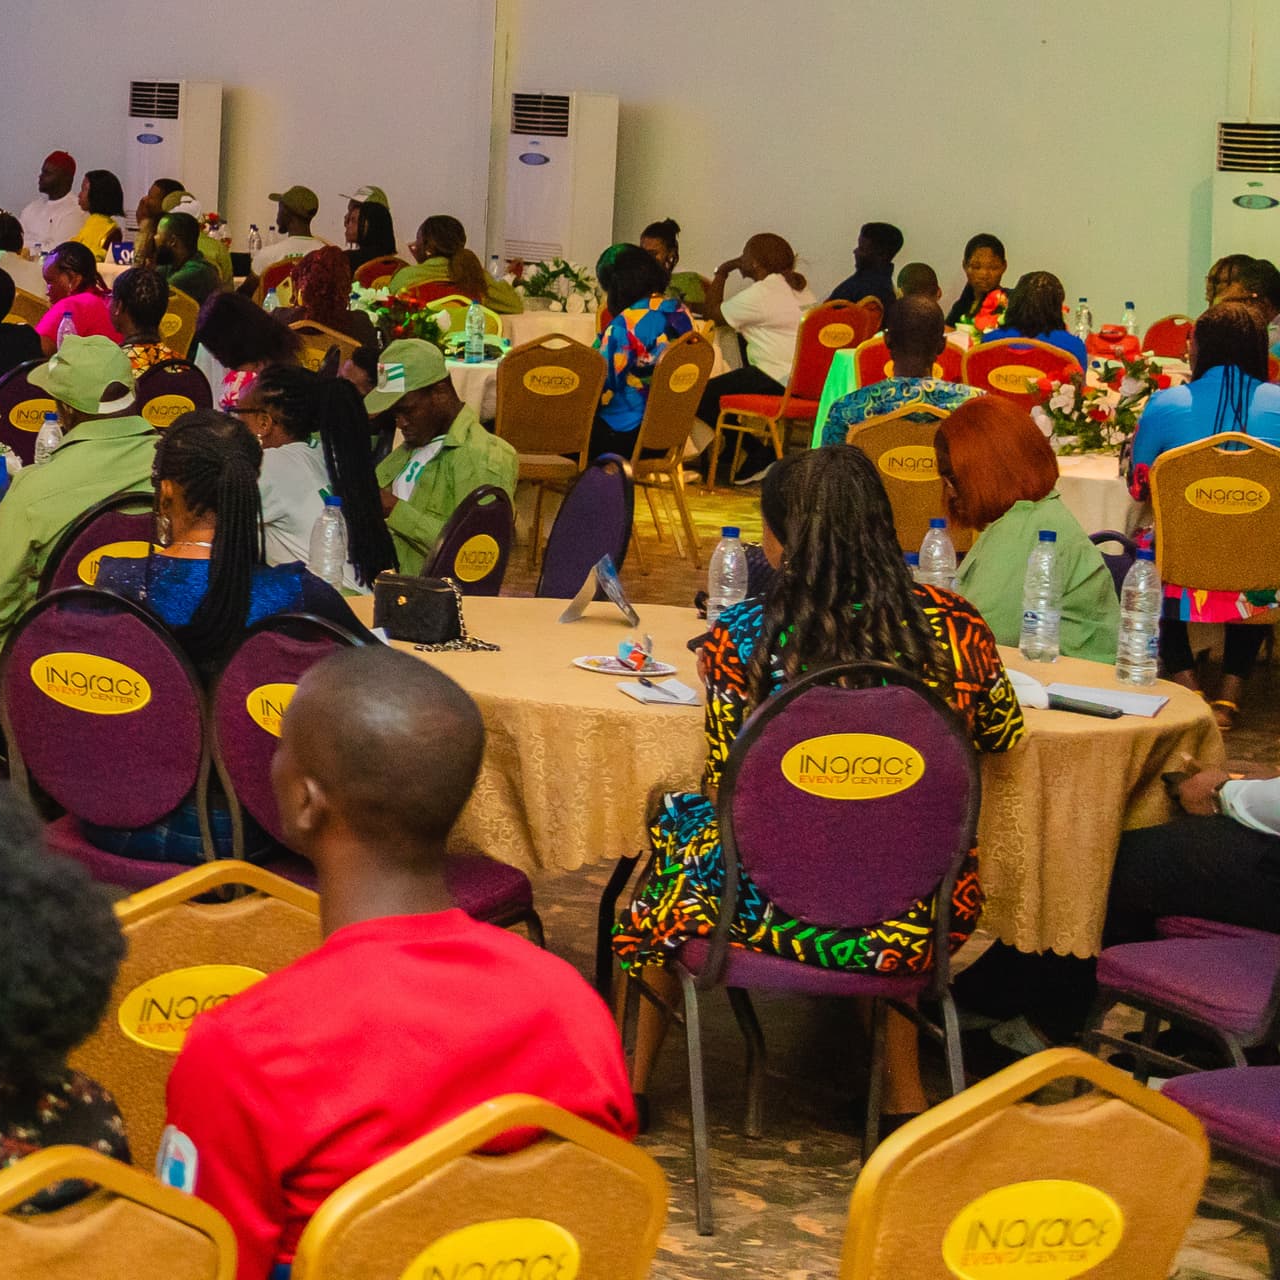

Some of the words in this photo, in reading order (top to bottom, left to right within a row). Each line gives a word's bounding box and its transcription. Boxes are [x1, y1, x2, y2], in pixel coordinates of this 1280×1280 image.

[90, 692, 134, 705] CENTER
[800, 774, 840, 785] EVENT
[851, 775, 904, 786] CENTER
